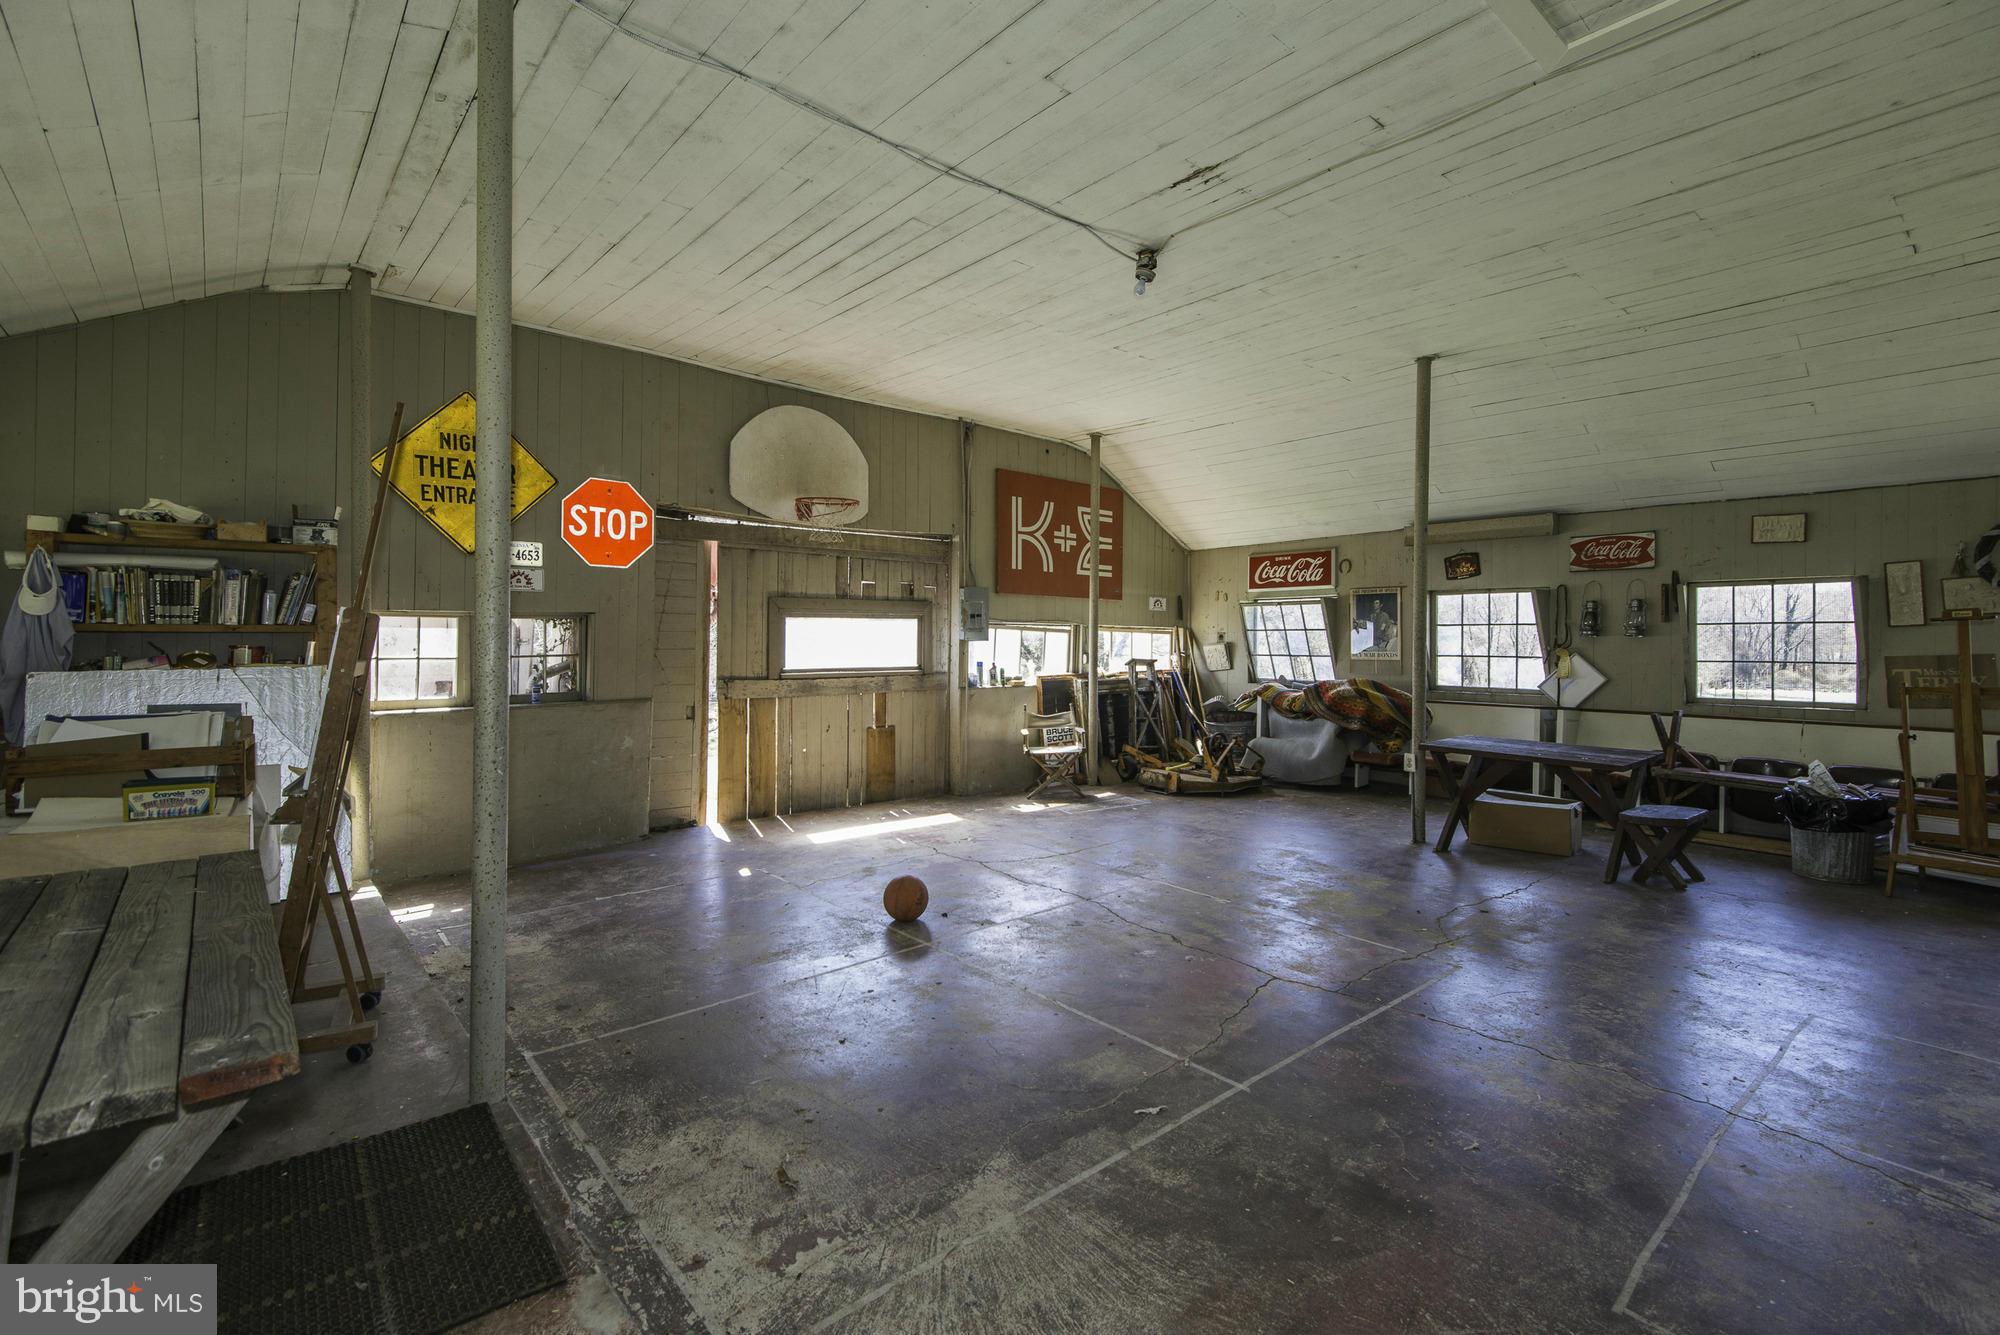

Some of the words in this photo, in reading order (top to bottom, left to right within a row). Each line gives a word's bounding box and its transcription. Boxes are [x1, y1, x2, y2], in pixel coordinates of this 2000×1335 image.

[439, 431, 476, 452] NIG
[568, 503, 648, 541] STOP
[512, 549, 540, 561] -4653
[1254, 556, 1327, 585] Coca-Cola
[1046, 727, 1073, 736] BRUCE
[1046, 733, 1073, 743] SCOTT
[152, 790, 186, 799] Crayola
